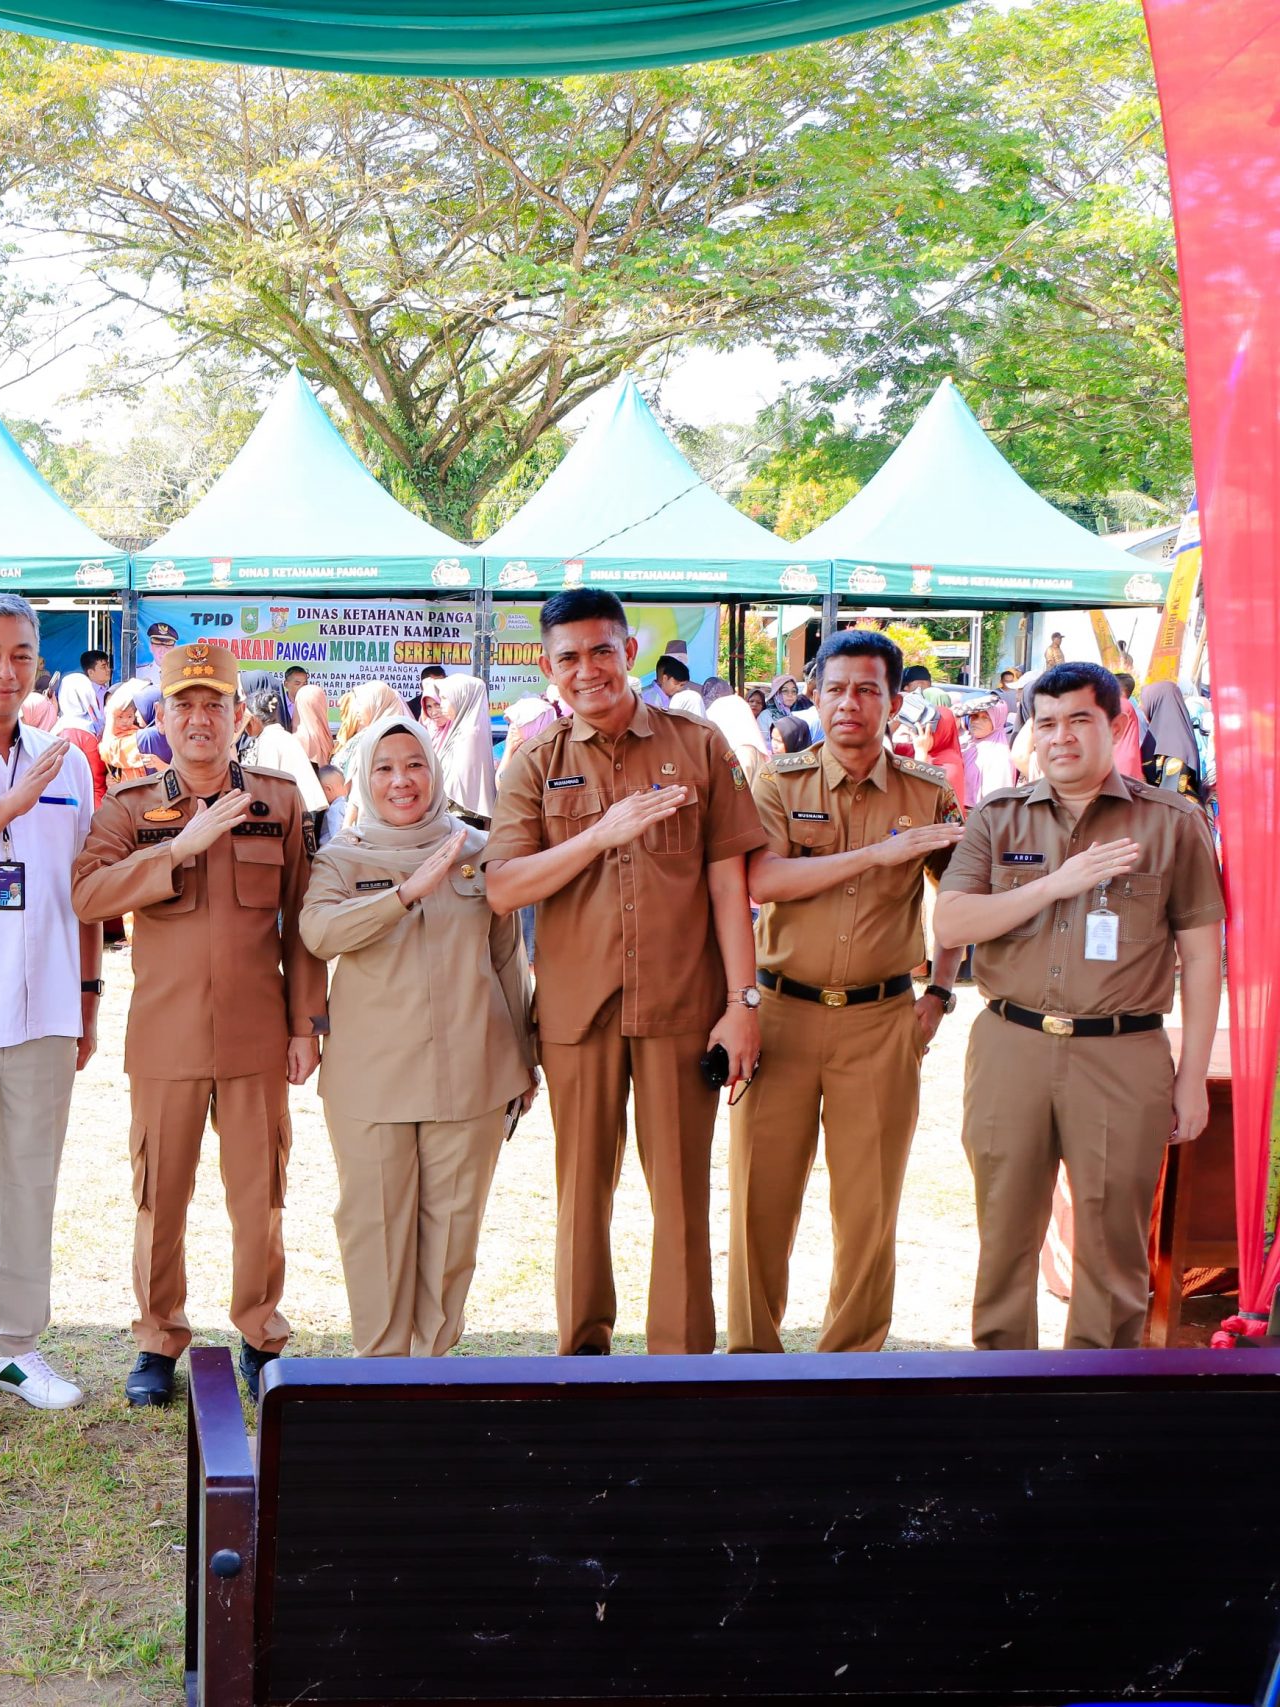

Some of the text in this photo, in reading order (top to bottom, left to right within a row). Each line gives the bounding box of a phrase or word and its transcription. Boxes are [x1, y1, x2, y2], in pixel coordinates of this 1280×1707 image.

[238, 566, 378, 578] DINAS KETAHANAN PANGAN
[590, 570, 728, 582] DINAS KETAHANAN PANGAN
[937, 575, 1073, 589] DINAS KETAHANAN PANGAN
[190, 612, 234, 626] TPID
[297, 608, 473, 623] DINAS KETAHANAN PANGA
[319, 624, 460, 638] KABUPATEN KAMPAR
[276, 642, 327, 661] PANGAN
[329, 640, 390, 663] MURAH
[393, 641, 472, 665] SERENTAK
[359, 665, 386, 673] DALAM
[349, 673, 377, 681] HARGA
[508, 675, 540, 683] INFLASI
